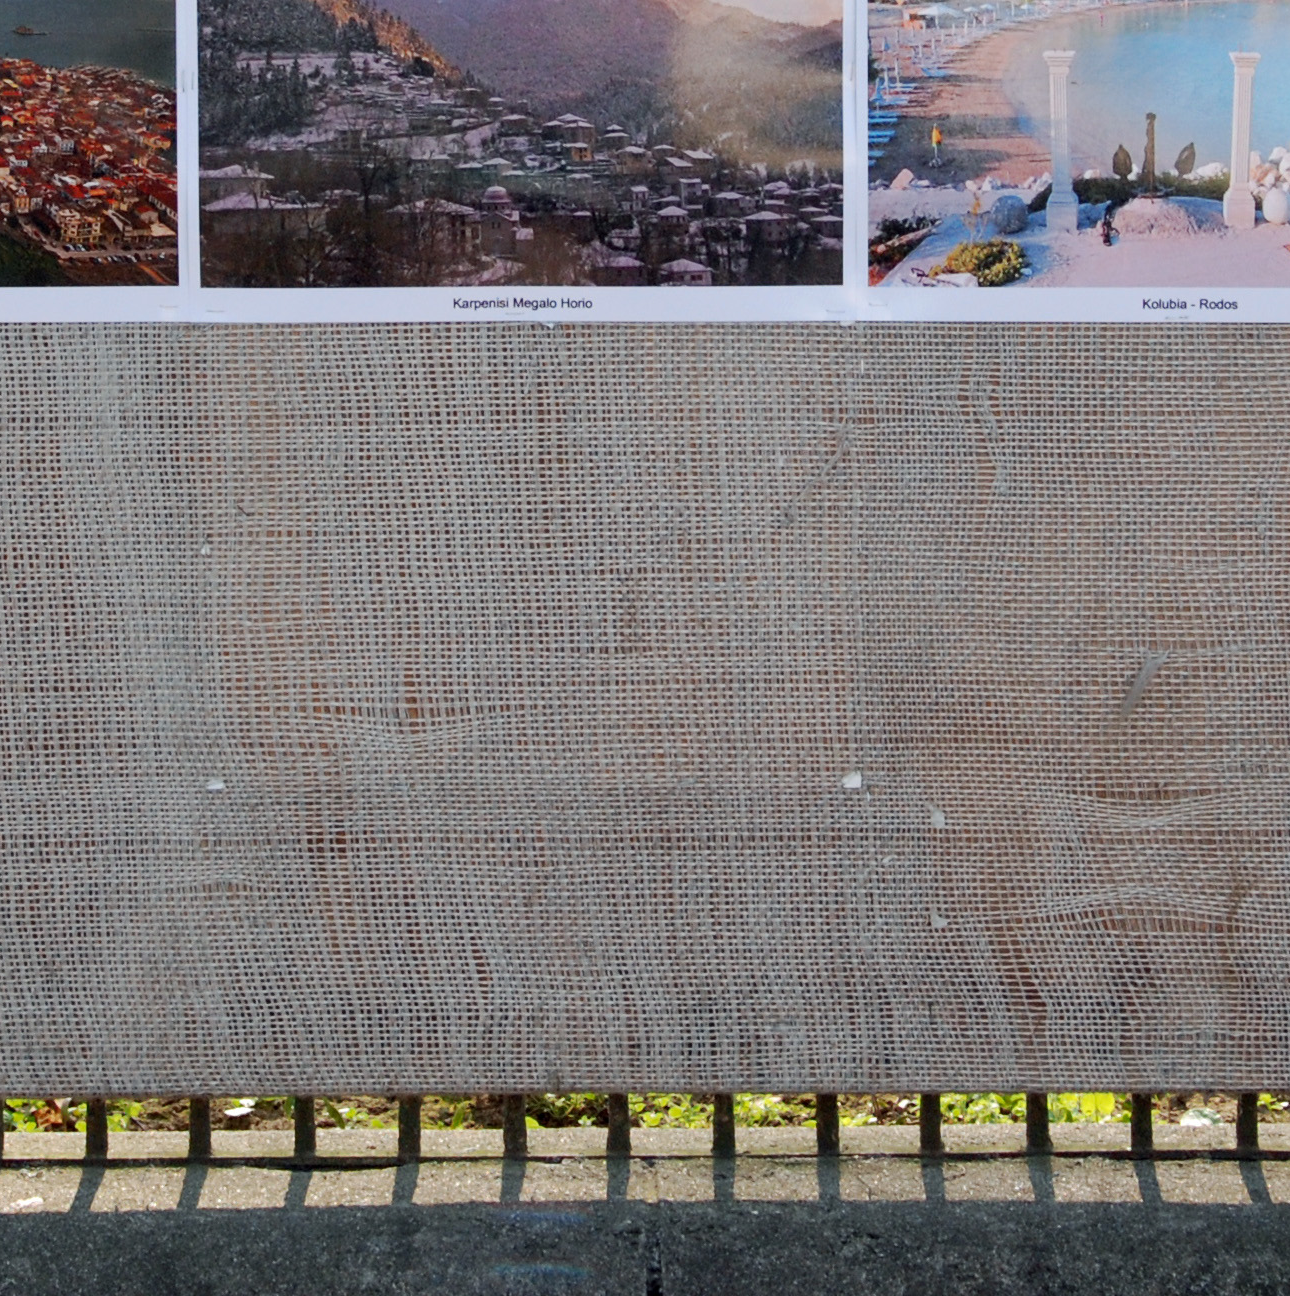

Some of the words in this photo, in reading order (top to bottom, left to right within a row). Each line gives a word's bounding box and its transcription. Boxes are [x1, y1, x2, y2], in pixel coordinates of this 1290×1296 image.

[453, 297, 509, 311] Karpenisi
[513, 297, 557, 311] Megalo
[561, 297, 593, 308] Horio
[1142, 298, 1187, 309] Kolubia
[1199, 298, 1238, 309] Rodos
